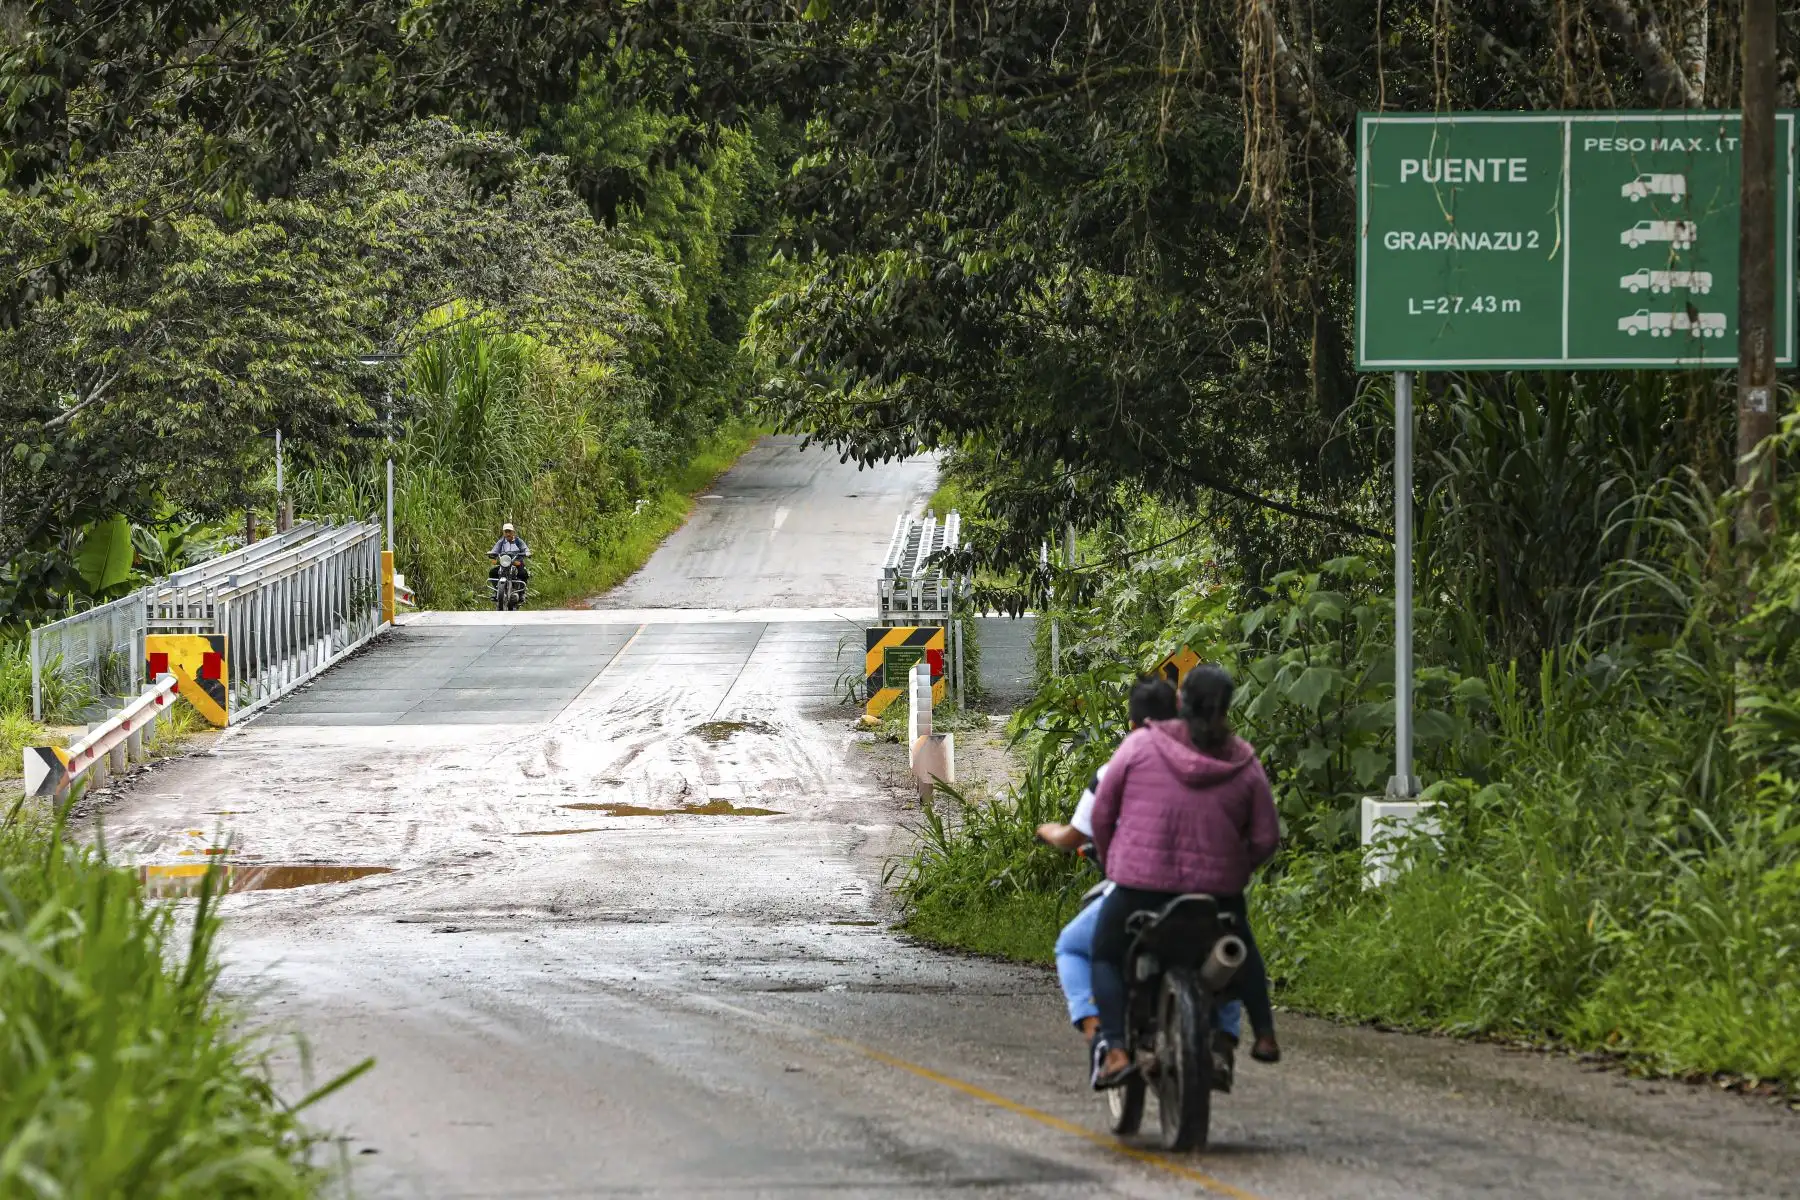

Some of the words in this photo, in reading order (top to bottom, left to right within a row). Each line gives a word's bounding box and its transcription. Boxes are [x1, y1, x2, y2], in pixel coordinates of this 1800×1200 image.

[1584, 138, 1644, 152] PESO
[1400, 157, 1528, 183] PUENTE
[1384, 231, 1521, 251] GRAPANAZU
[1527, 230, 1539, 249] 2
[1408, 296, 1498, 315] L=27.43
[1501, 297, 1521, 313] m
